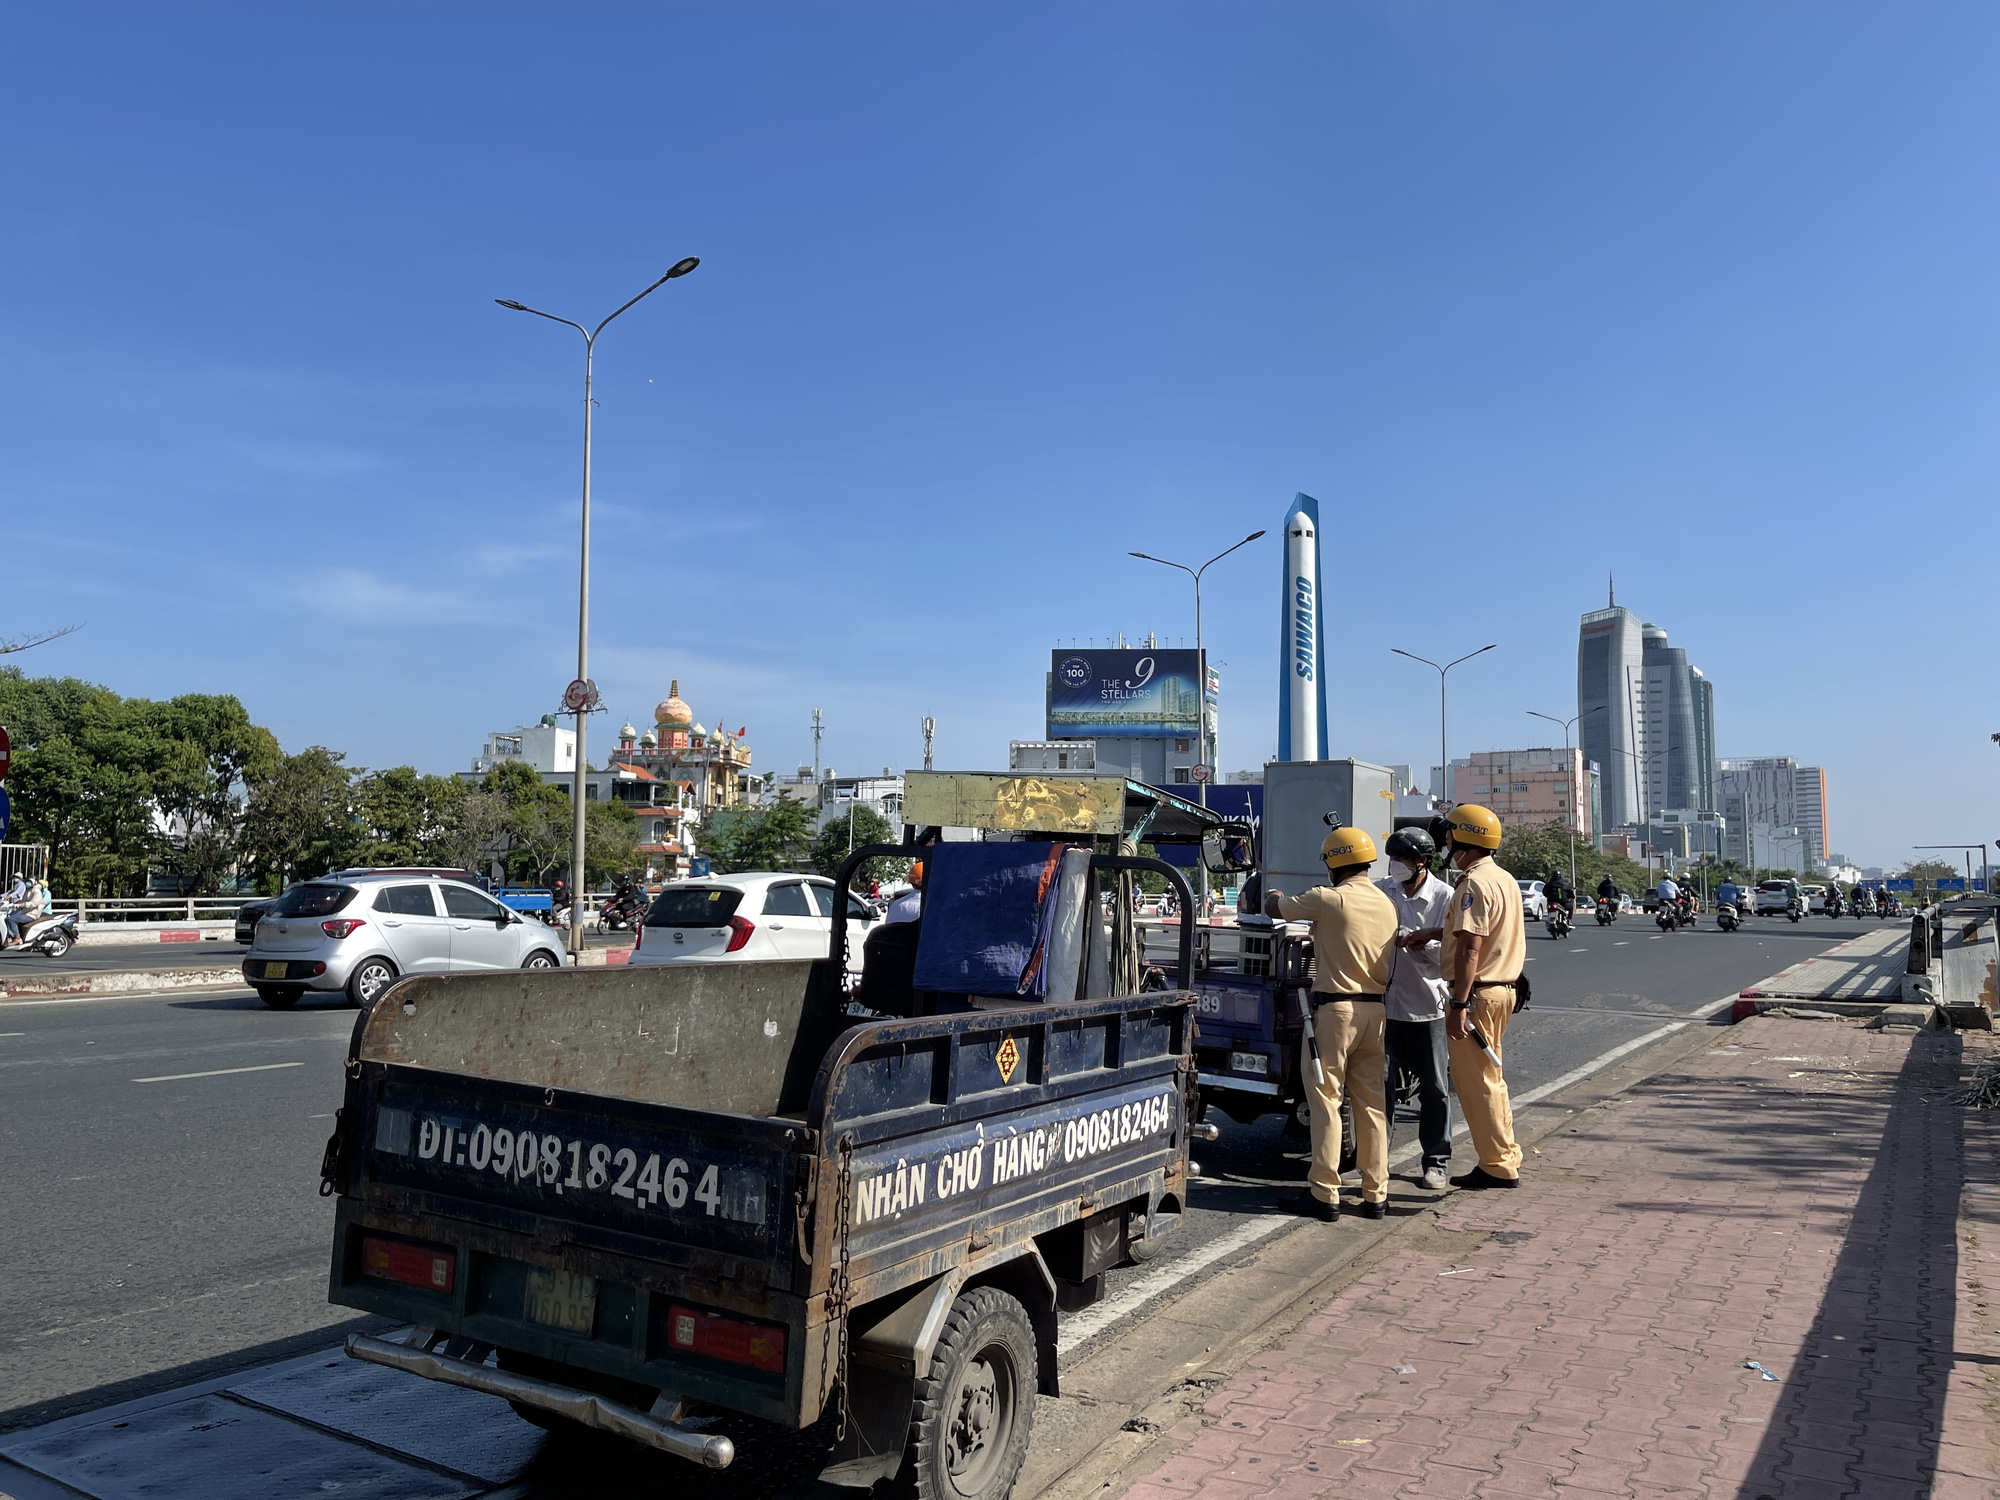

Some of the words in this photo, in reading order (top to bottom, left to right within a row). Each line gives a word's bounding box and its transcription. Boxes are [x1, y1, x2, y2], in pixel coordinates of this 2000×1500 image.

[1295, 575, 1314, 682] SAWACO
[1066, 669, 1085, 678] 100
[1101, 679, 1120, 689] THE
[1125, 657, 1155, 689] 9
[1101, 689, 1152, 699] STELLARS
[1458, 823, 1489, 836] CSGT
[1327, 845, 1354, 858] CSGT
[855, 1158, 927, 1226] NHẬN
[937, 1121, 985, 1200] CHỞ
[993, 1126, 1044, 1185] HÀNG
